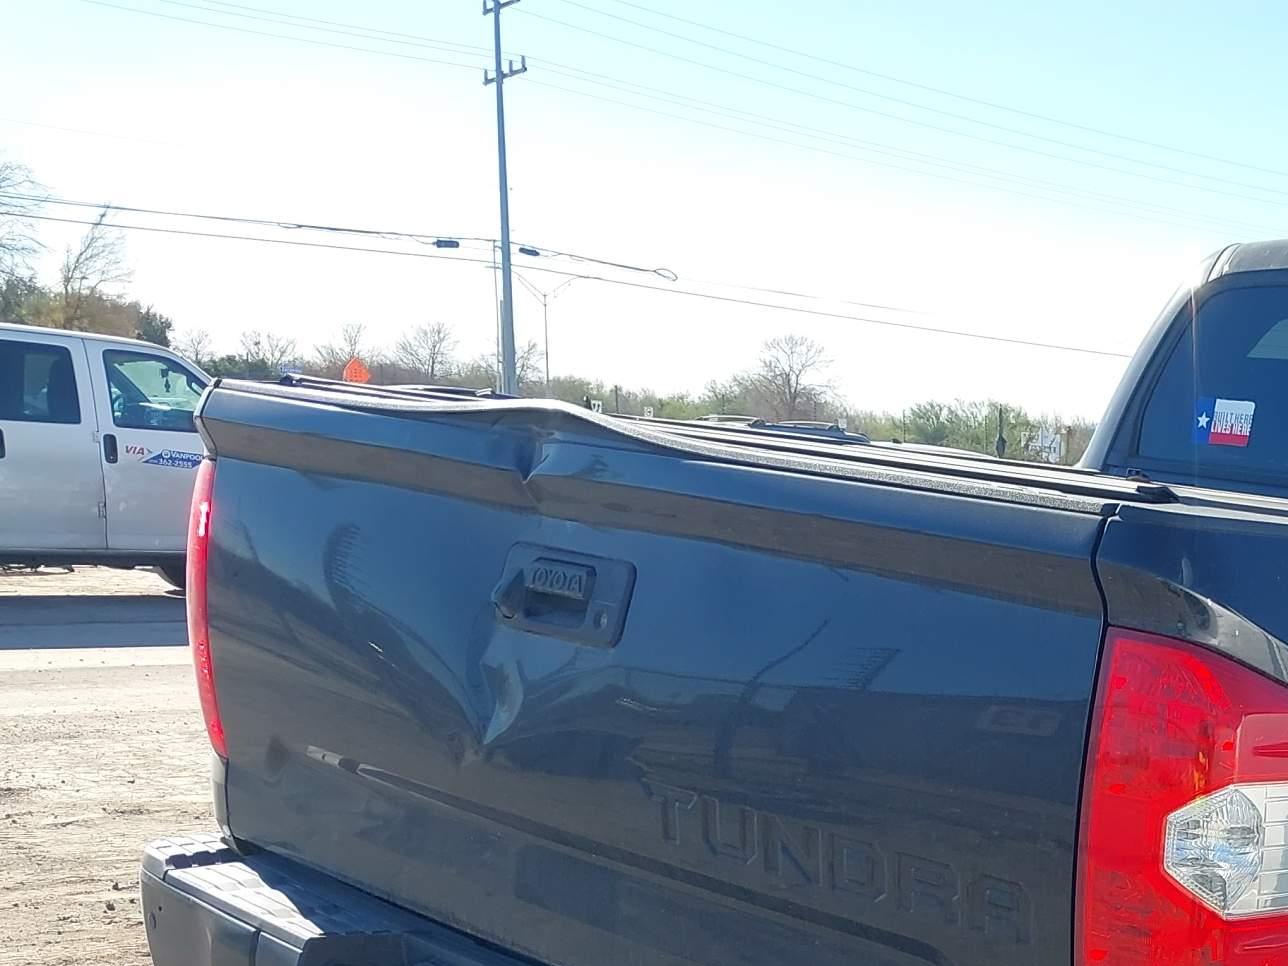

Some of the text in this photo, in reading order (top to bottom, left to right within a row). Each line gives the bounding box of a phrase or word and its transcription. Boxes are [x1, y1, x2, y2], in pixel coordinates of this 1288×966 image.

[125, 445, 145, 456] VIA
[528, 566, 584, 595] TOYOTA
[650, 783, 1033, 944] TUNDRA
